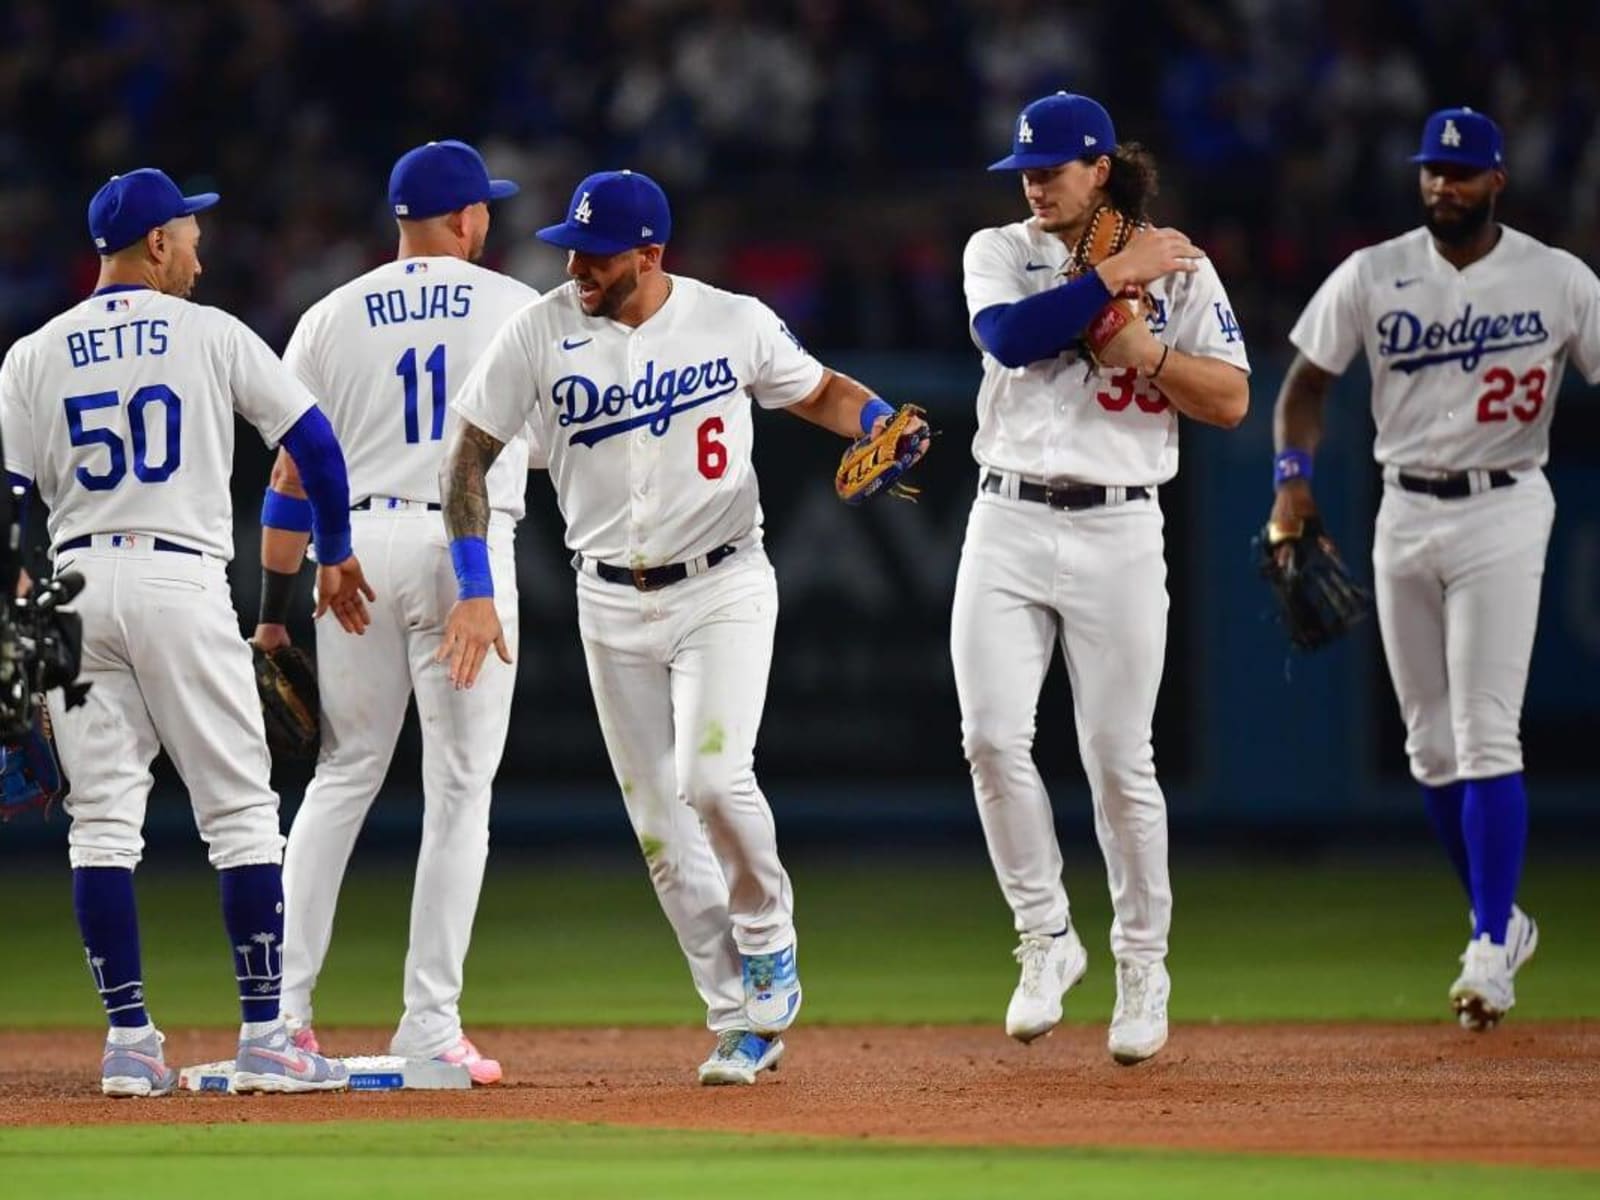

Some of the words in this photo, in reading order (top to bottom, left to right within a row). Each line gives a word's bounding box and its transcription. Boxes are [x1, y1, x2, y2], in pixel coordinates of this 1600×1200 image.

[365, 285, 473, 327] ROJAS
[1377, 304, 1548, 373] Dodgers
[67, 320, 168, 368] BETTS
[396, 343, 446, 445] 11
[552, 357, 738, 447] Dodgers
[1477, 367, 1547, 423] 23
[64, 384, 181, 491] 50
[697, 416, 728, 480] 6
